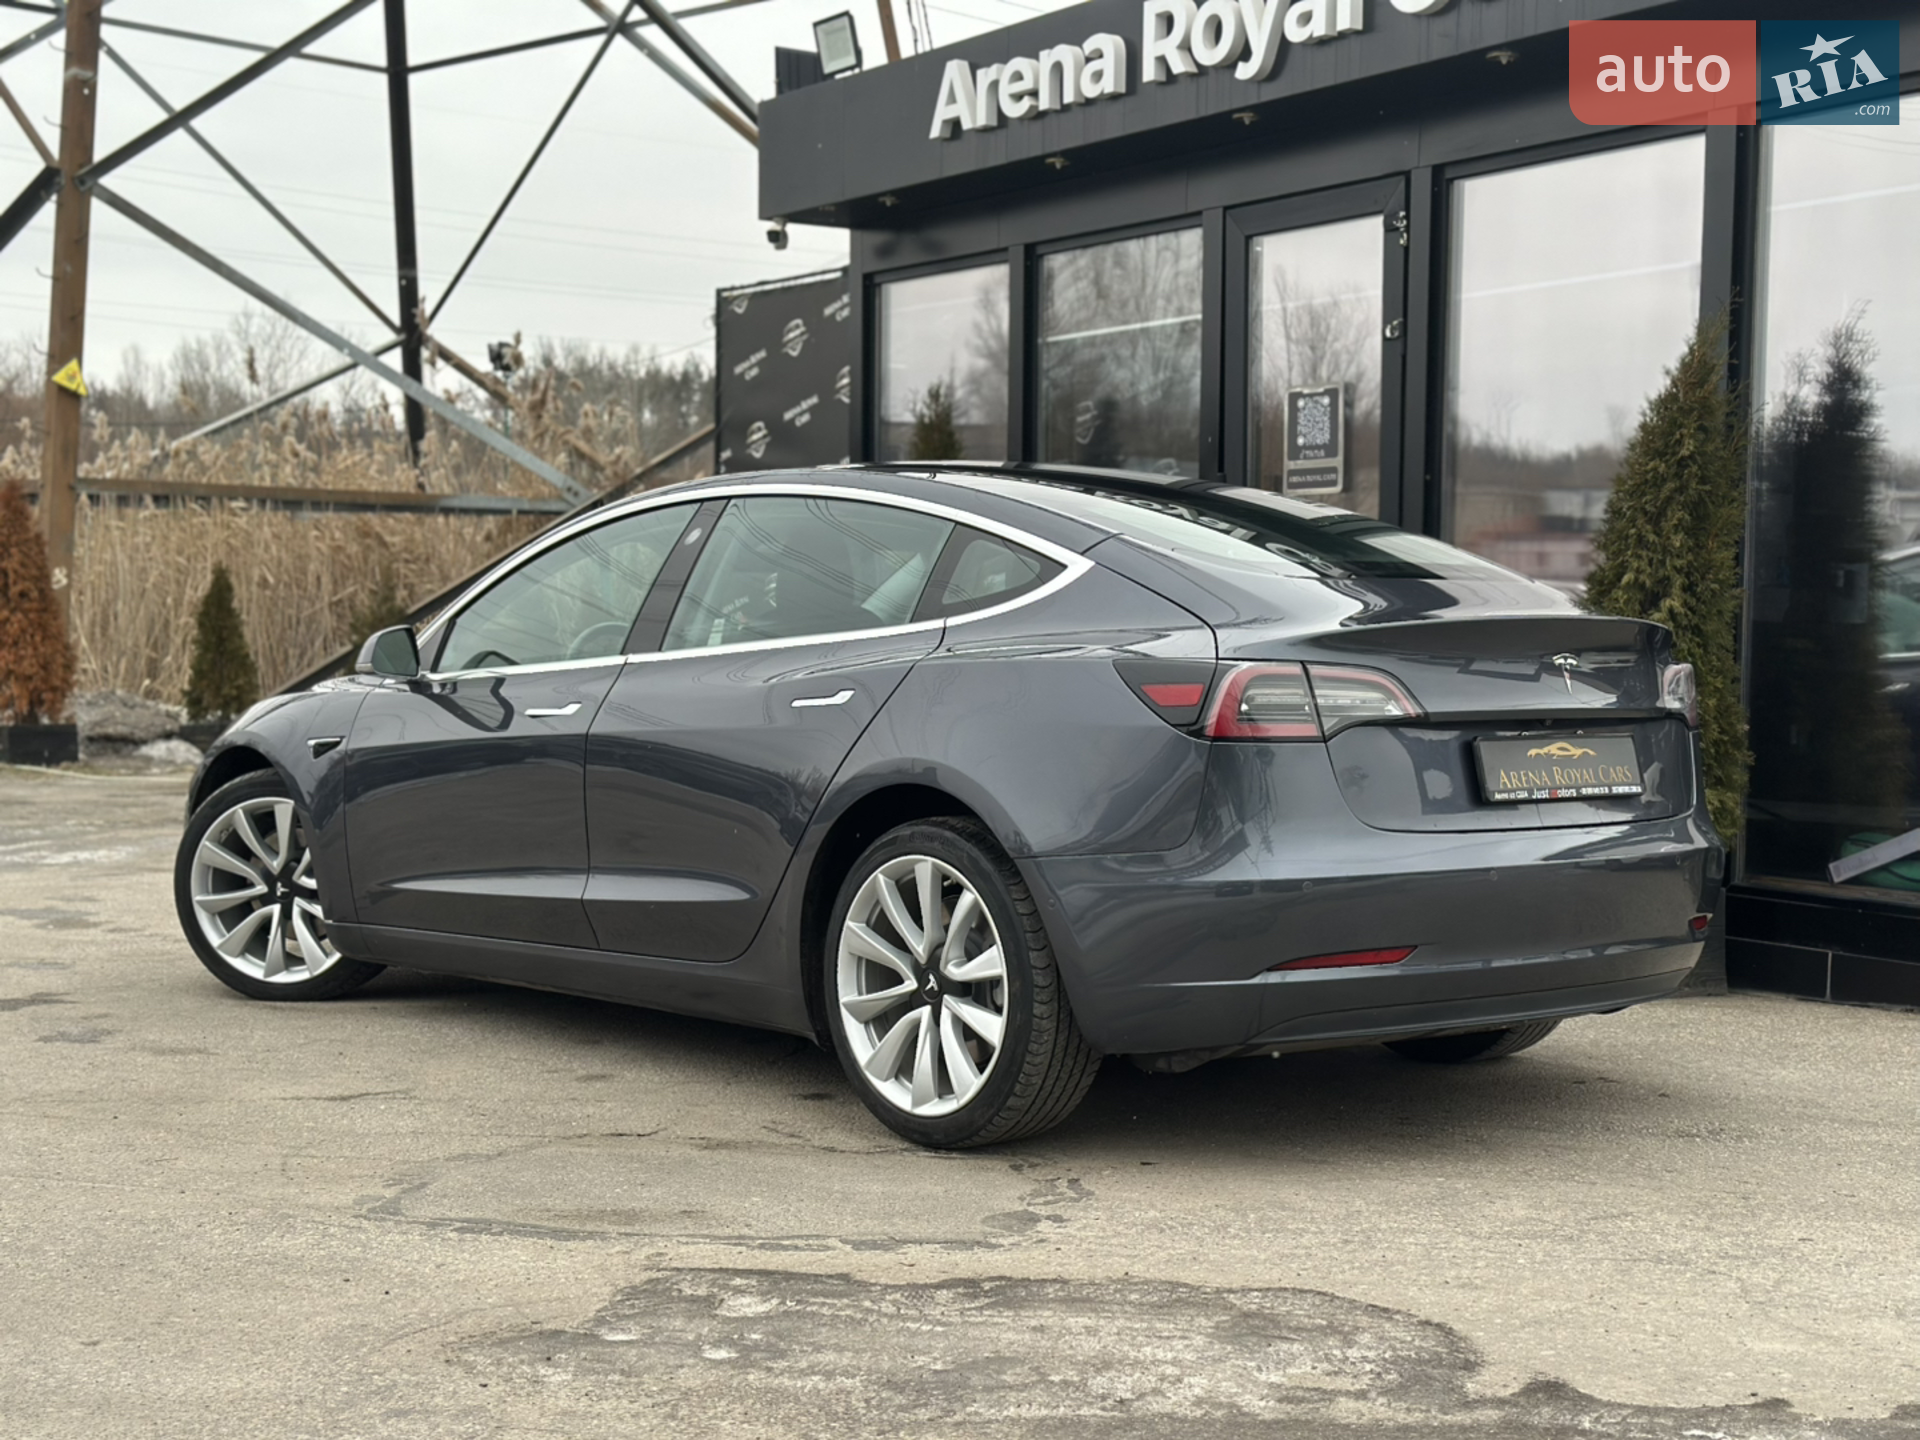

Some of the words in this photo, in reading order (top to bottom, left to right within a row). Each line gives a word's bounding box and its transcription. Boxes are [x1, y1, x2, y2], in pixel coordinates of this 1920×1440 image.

[929, 32, 1127, 140] Arena
[1499, 769, 1551, 789] ARENA
[1552, 766, 1597, 786] ROYAL
[1598, 764, 1633, 783] CARS
[1531, 788, 1550, 799] Just
